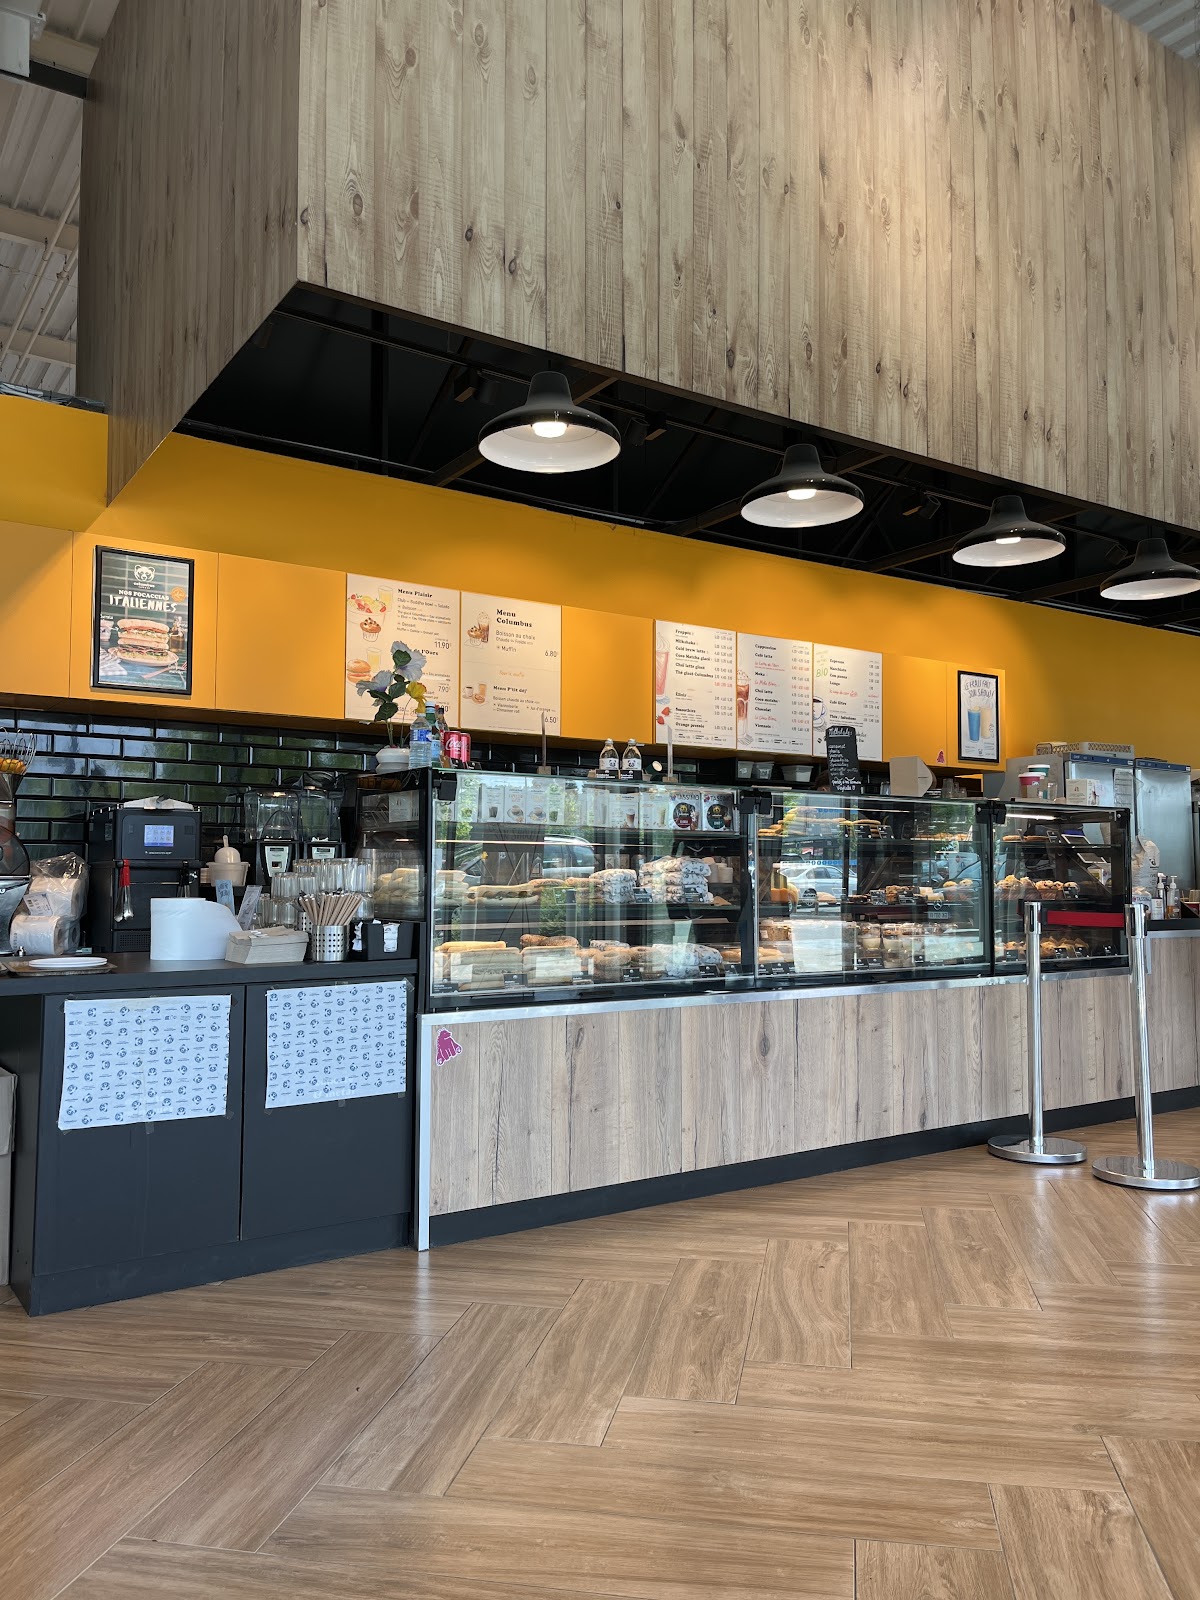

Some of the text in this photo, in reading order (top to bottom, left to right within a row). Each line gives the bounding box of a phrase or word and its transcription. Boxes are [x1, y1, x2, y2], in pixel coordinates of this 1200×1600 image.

[133, 590, 170, 600] FOCACCIAS
[414, 590, 433, 598] Plaisir
[110, 594, 178, 613] ITALIENNES
[496, 609, 516, 617] Menu
[496, 617, 533, 628] Columbus
[496, 630, 515, 638] Boisson
[816, 667, 828, 677] BIO
